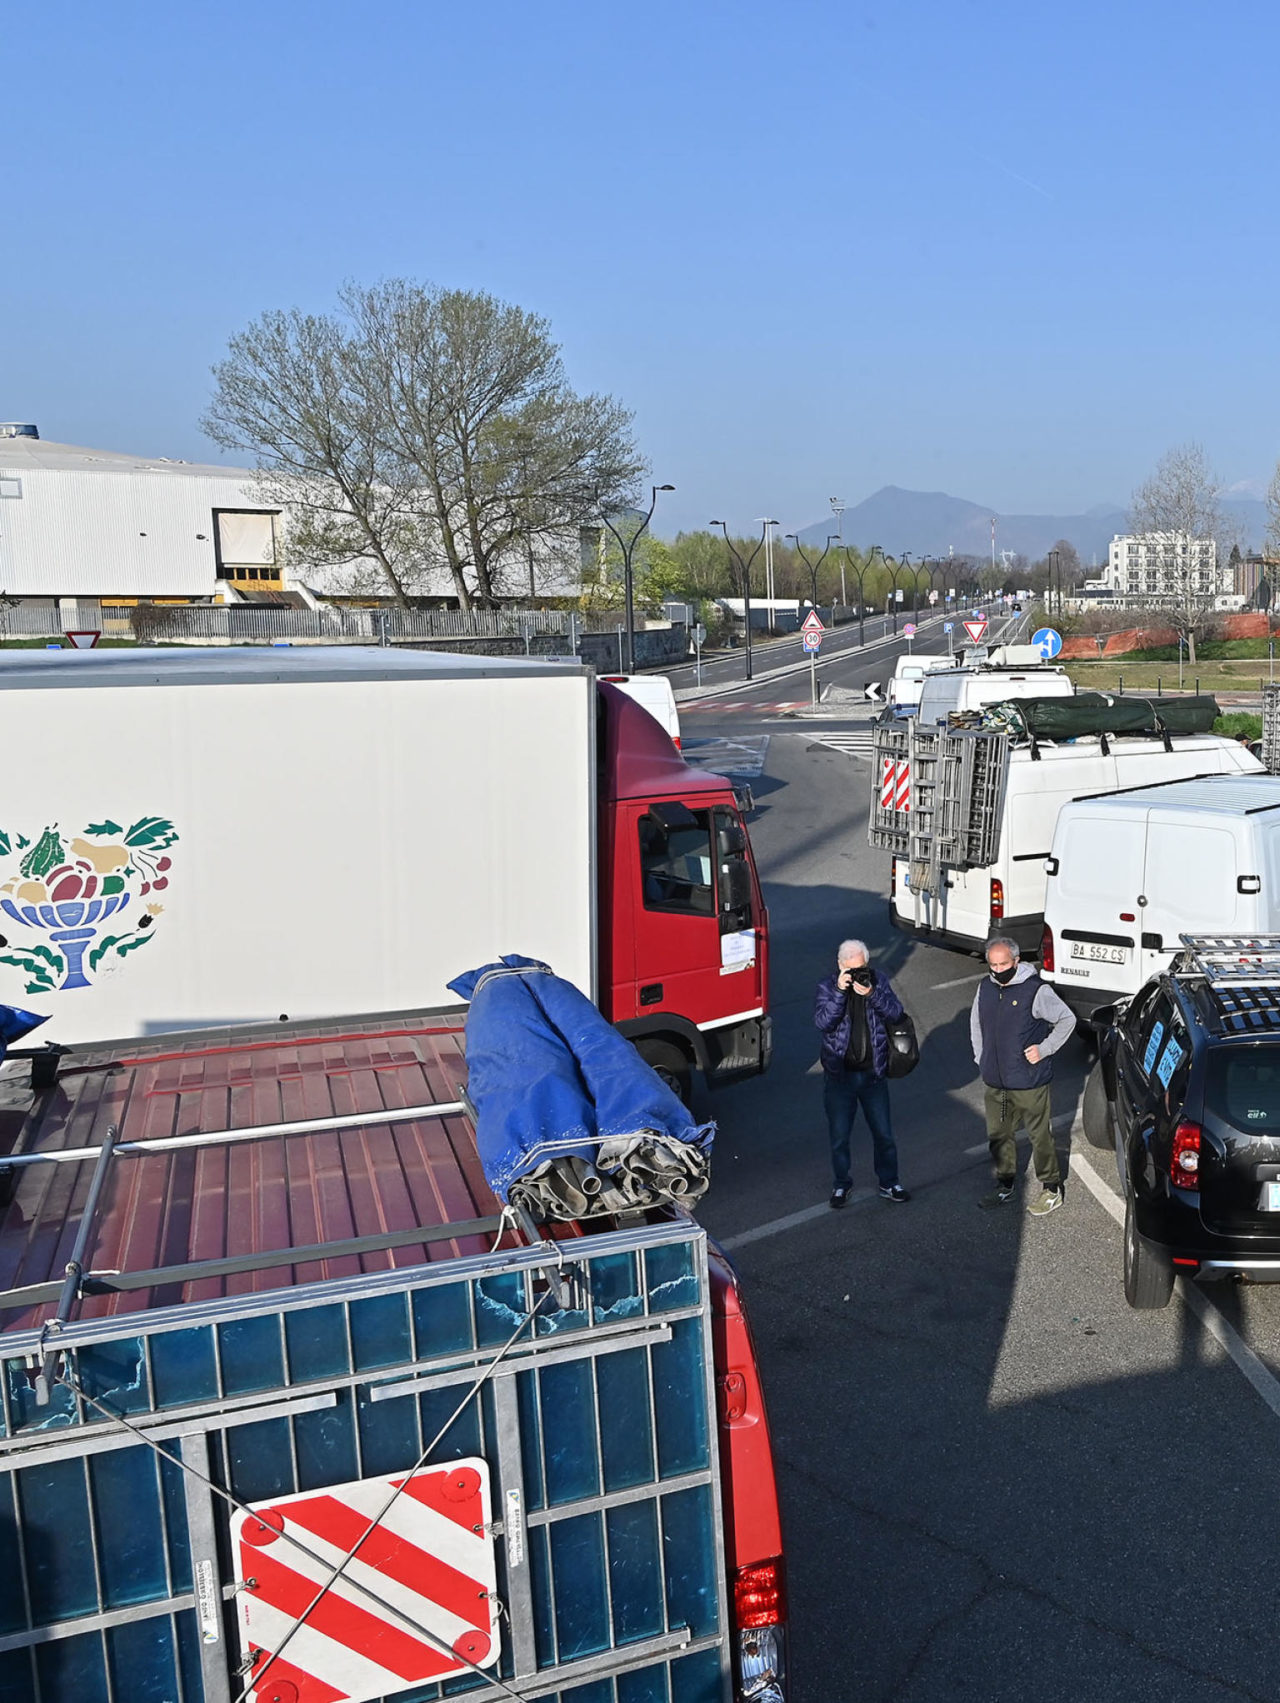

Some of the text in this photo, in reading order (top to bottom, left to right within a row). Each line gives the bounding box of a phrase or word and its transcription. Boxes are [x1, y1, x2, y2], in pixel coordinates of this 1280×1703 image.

[1073, 943, 1124, 962] BA 552 CS
[1060, 967, 1091, 978] RENAULT
